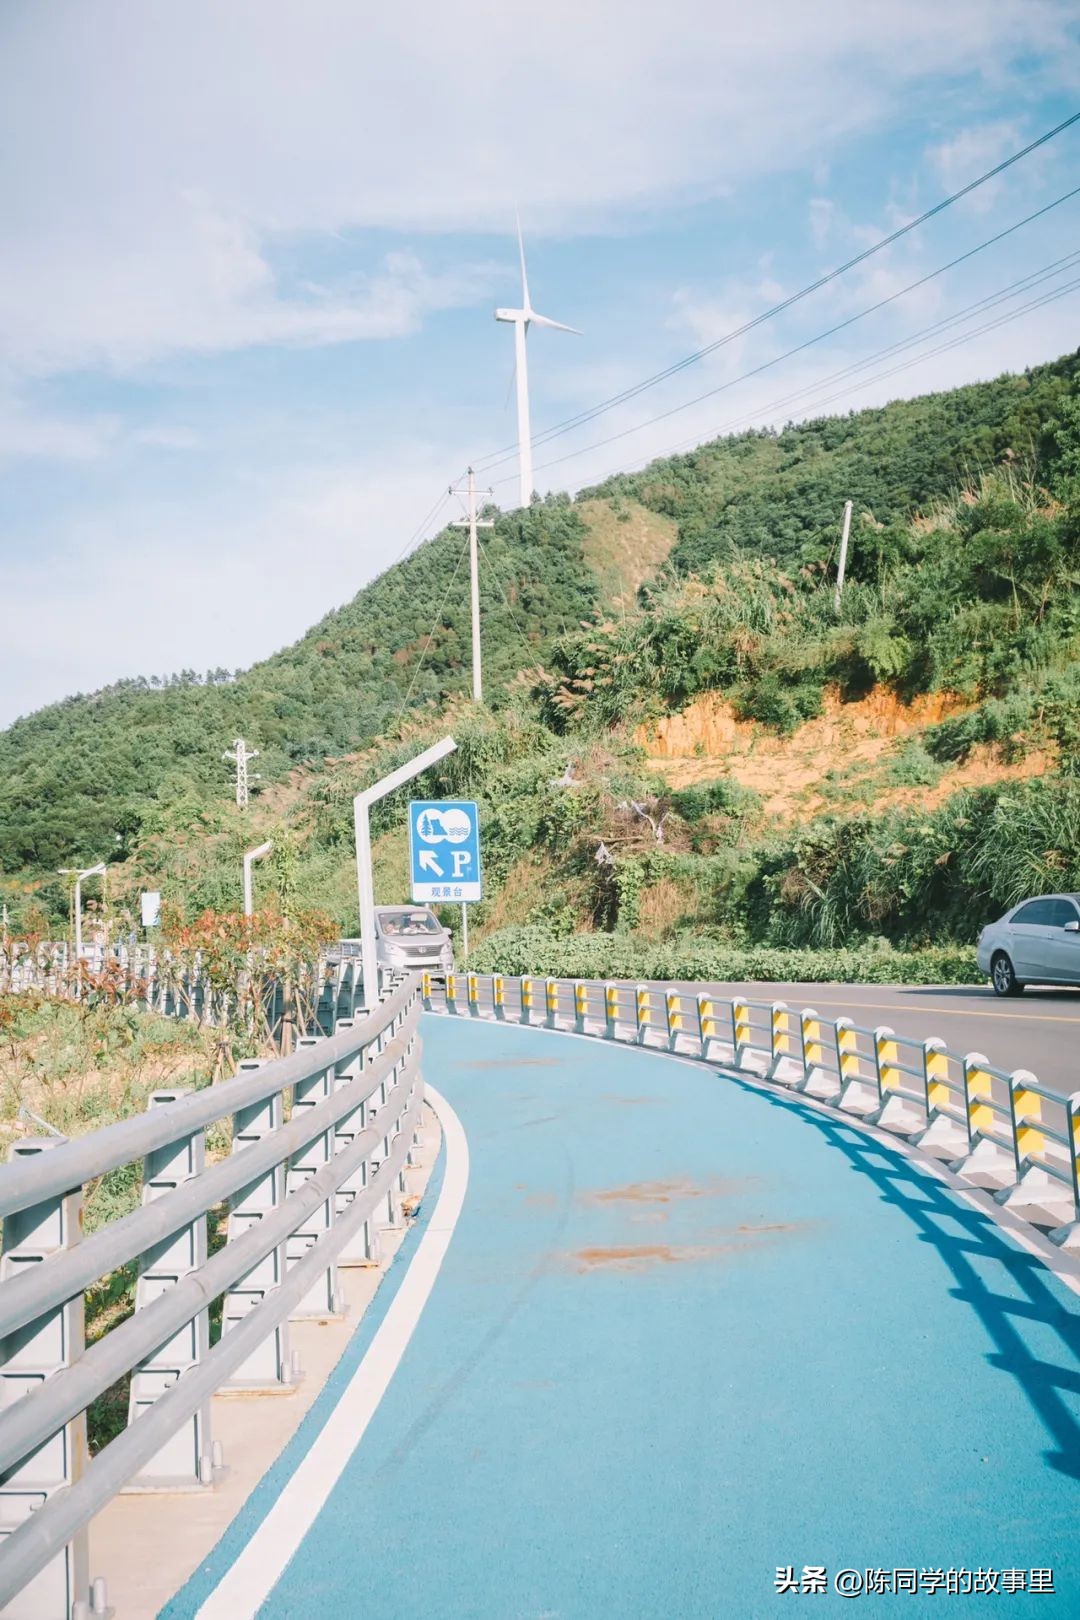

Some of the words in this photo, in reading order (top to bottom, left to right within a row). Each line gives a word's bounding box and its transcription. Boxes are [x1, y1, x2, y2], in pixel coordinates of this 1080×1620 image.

[450, 850, 472, 878] P
[431, 886, 463, 897] 观景台
